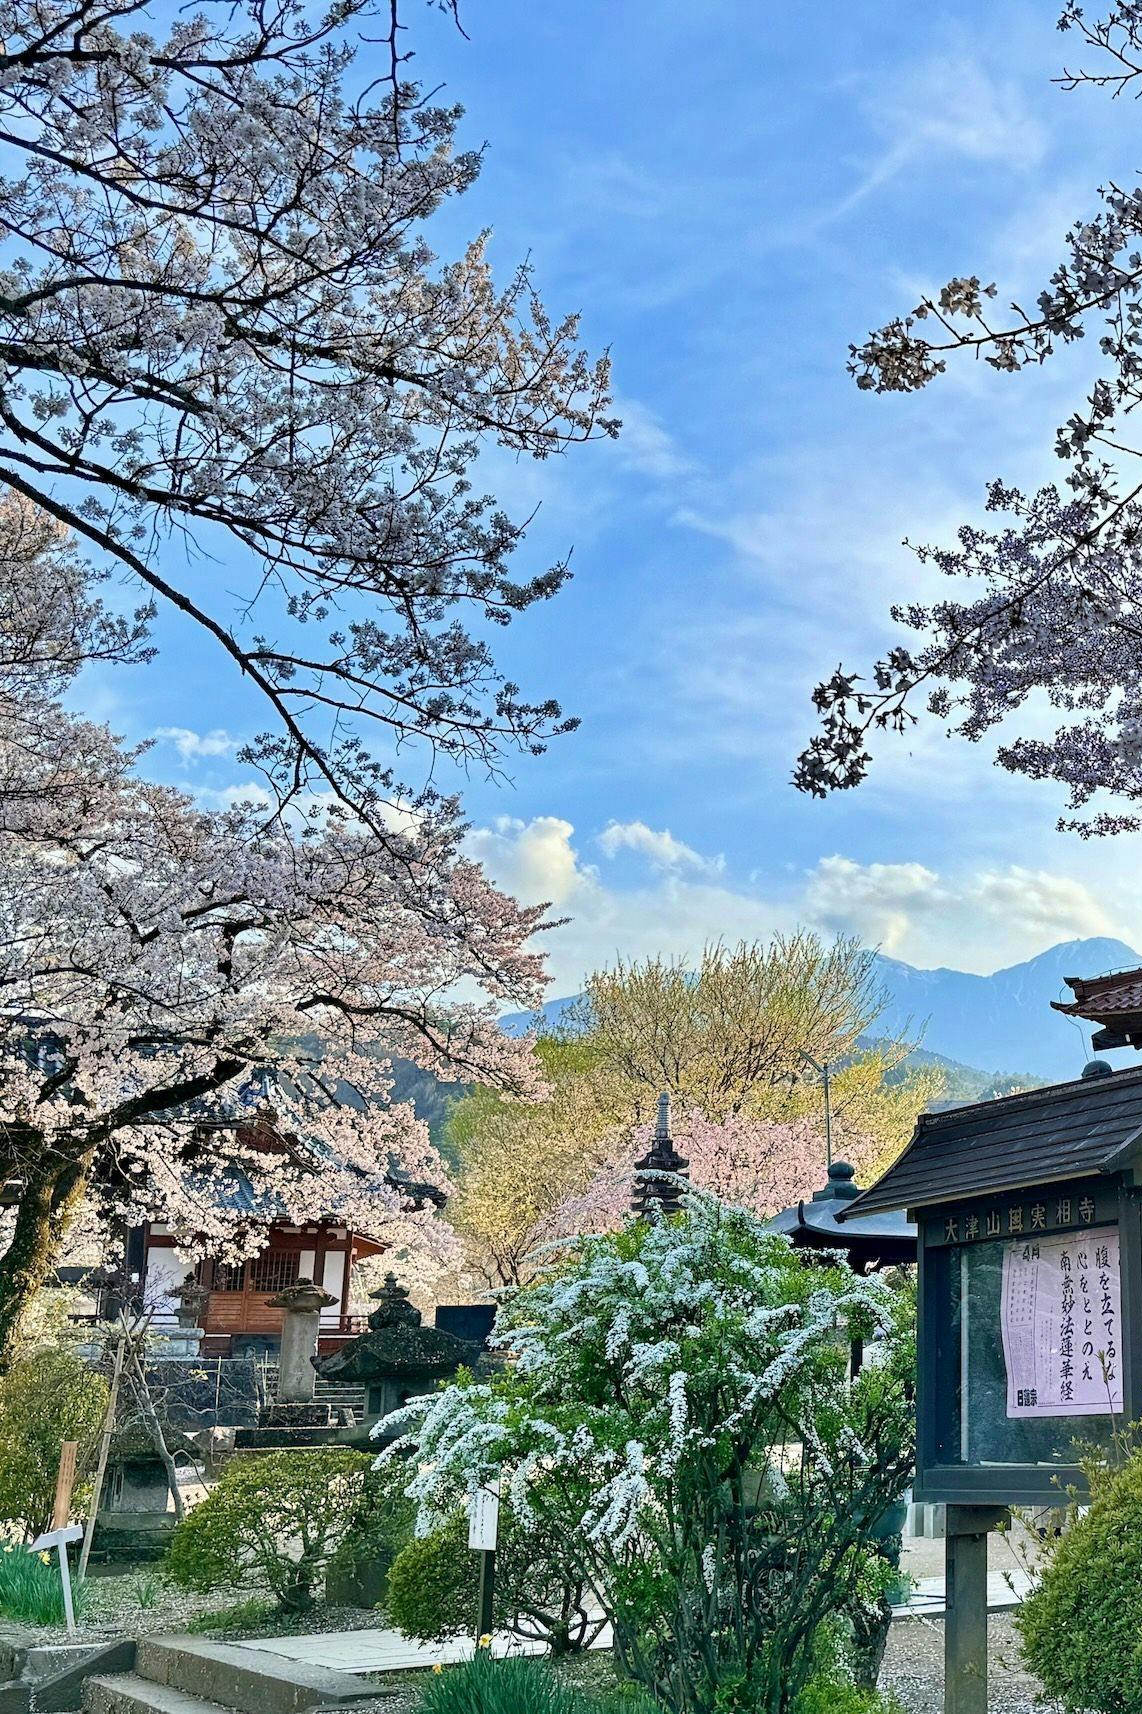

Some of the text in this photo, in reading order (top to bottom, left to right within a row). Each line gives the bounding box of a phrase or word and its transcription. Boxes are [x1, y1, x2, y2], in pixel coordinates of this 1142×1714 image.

[1060, 1250, 1076, 1402] 南無妙法蓮華経
[1077, 1251, 1094, 1381] 心をととのえ
[1095, 1245, 1116, 1381] 腹を立てるな
